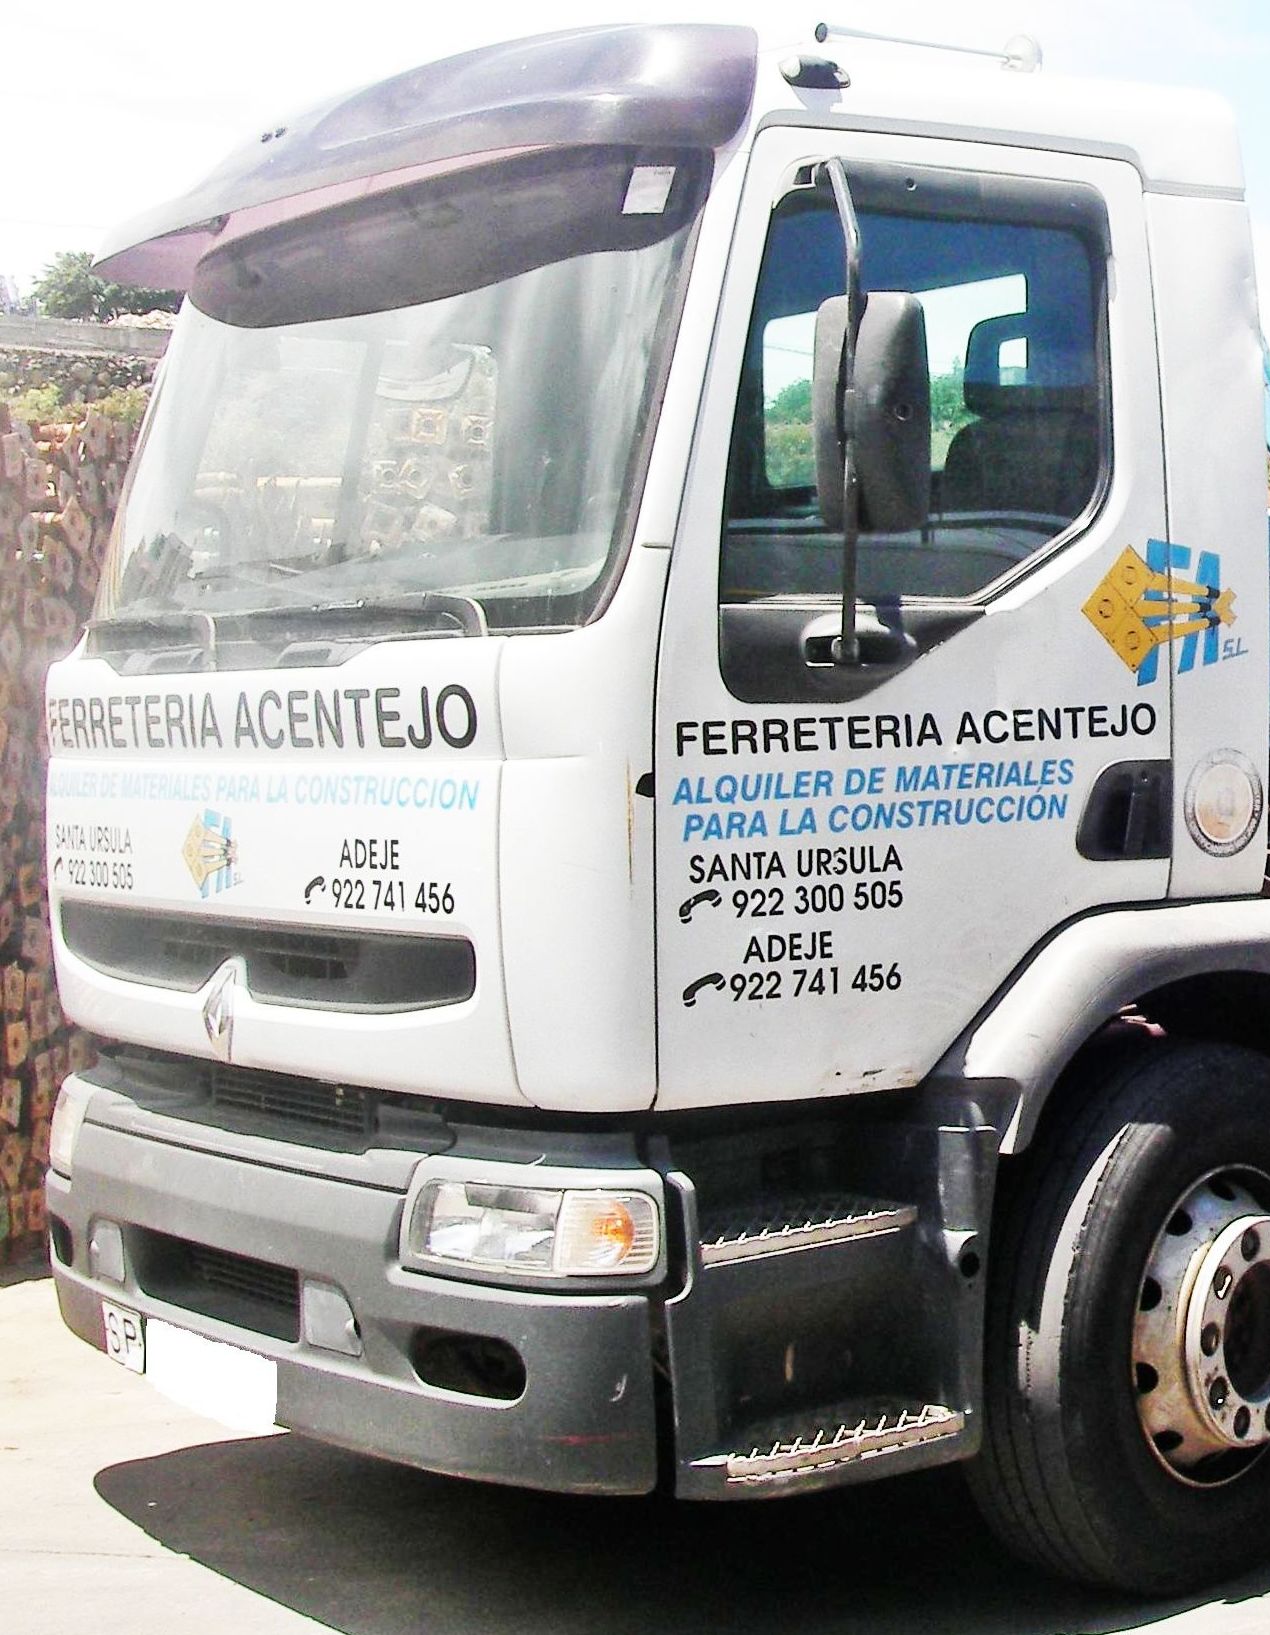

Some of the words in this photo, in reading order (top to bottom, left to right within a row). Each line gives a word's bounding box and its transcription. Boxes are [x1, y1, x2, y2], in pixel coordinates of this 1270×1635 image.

[49, 692, 222, 748] FERRETERIA
[234, 684, 478, 749] ACENTEJO
[676, 713, 943, 757] FERRETERIA
[956, 702, 1157, 745] ACENTEJO
[120, 771, 211, 801] MATERIALES
[215, 773, 260, 804] PARA
[265, 773, 289, 804] LA
[294, 774, 481, 811] CONSTRUCCION
[672, 768, 834, 806] ALQUILER
[843, 766, 887, 796] DE
[893, 758, 1075, 794] MATERIALES
[682, 809, 769, 843] PARA
[778, 806, 818, 837] LA
[827, 786, 1069, 834] CONSTRUCCIÓN
[55, 824, 85, 851] SANTA
[89, 825, 133, 855] URSULA
[339, 838, 400, 870] ADEJE
[68, 858, 87, 886] 922
[89, 860, 109, 887] 300
[112, 862, 134, 890] 505
[688, 850, 787, 884] SANTA
[796, 844, 904, 878] URSULA
[332, 878, 365, 909] 922
[372, 880, 405, 912] 741
[415, 882, 456, 915] 456
[732, 887, 785, 918] 922
[793, 883, 845, 914] 300
[853, 880, 904, 911] 505
[742, 931, 834, 965] ADEJE
[729, 971, 782, 1001] 922
[792, 967, 839, 997] 741
[851, 962, 902, 993] 456
[108, 1311, 137, 1354] SP
